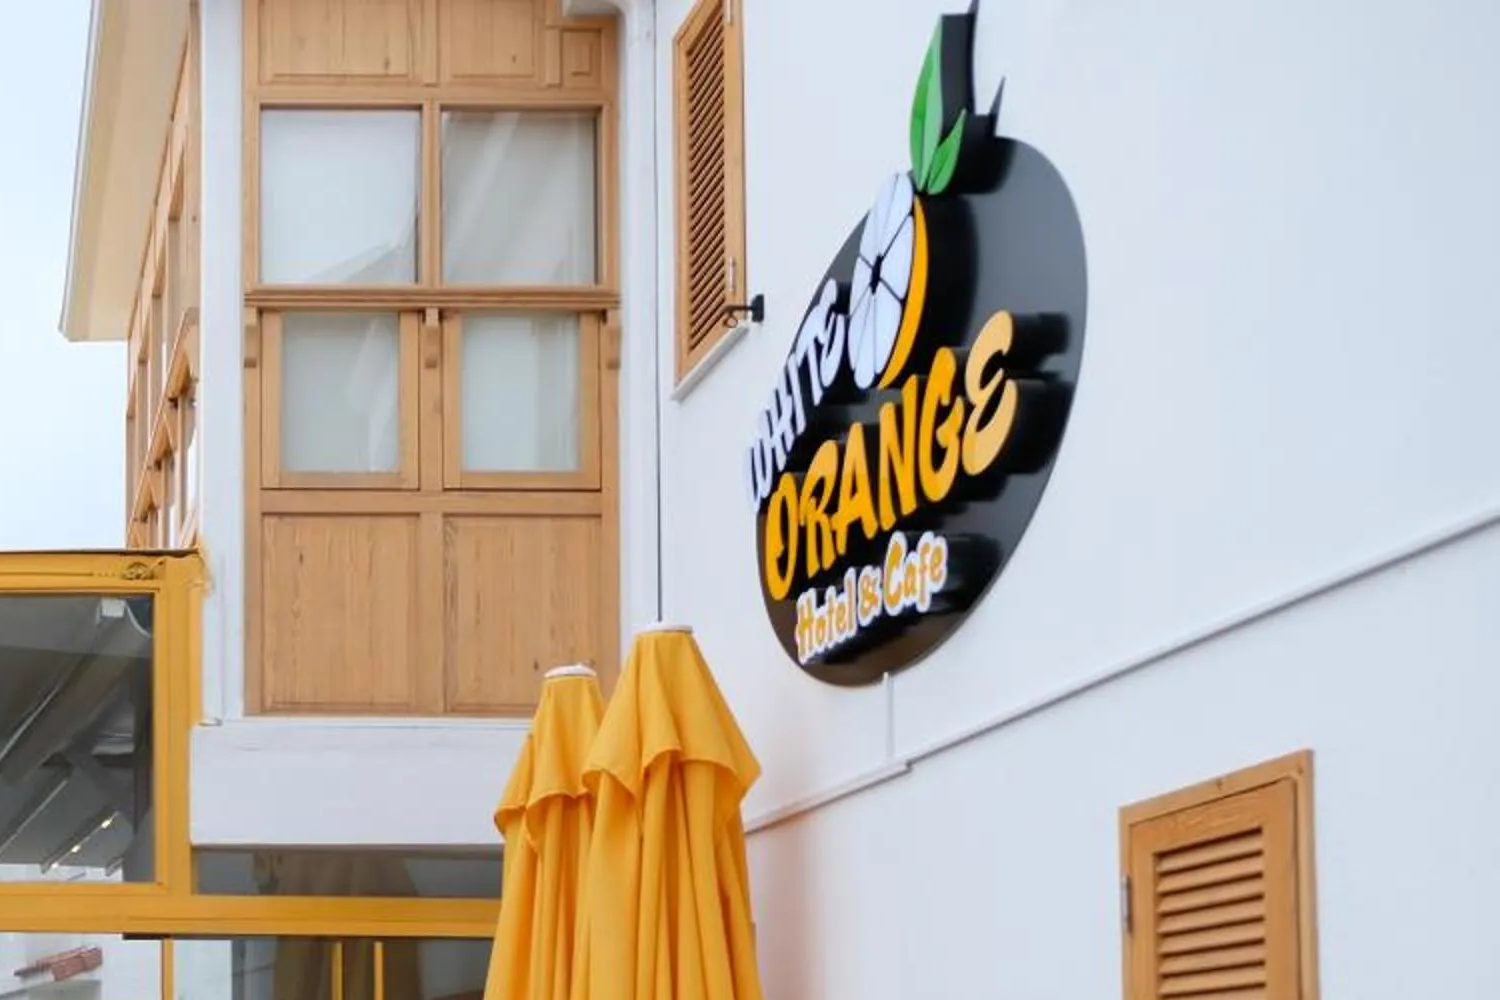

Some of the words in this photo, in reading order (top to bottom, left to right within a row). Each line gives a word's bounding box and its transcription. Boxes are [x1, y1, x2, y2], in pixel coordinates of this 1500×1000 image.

[745, 278, 846, 514] WHITE
[764, 308, 1018, 601] ORANGE
[795, 566, 857, 665] Hotel
[858, 565, 882, 627] &
[883, 531, 949, 617] Cafe
